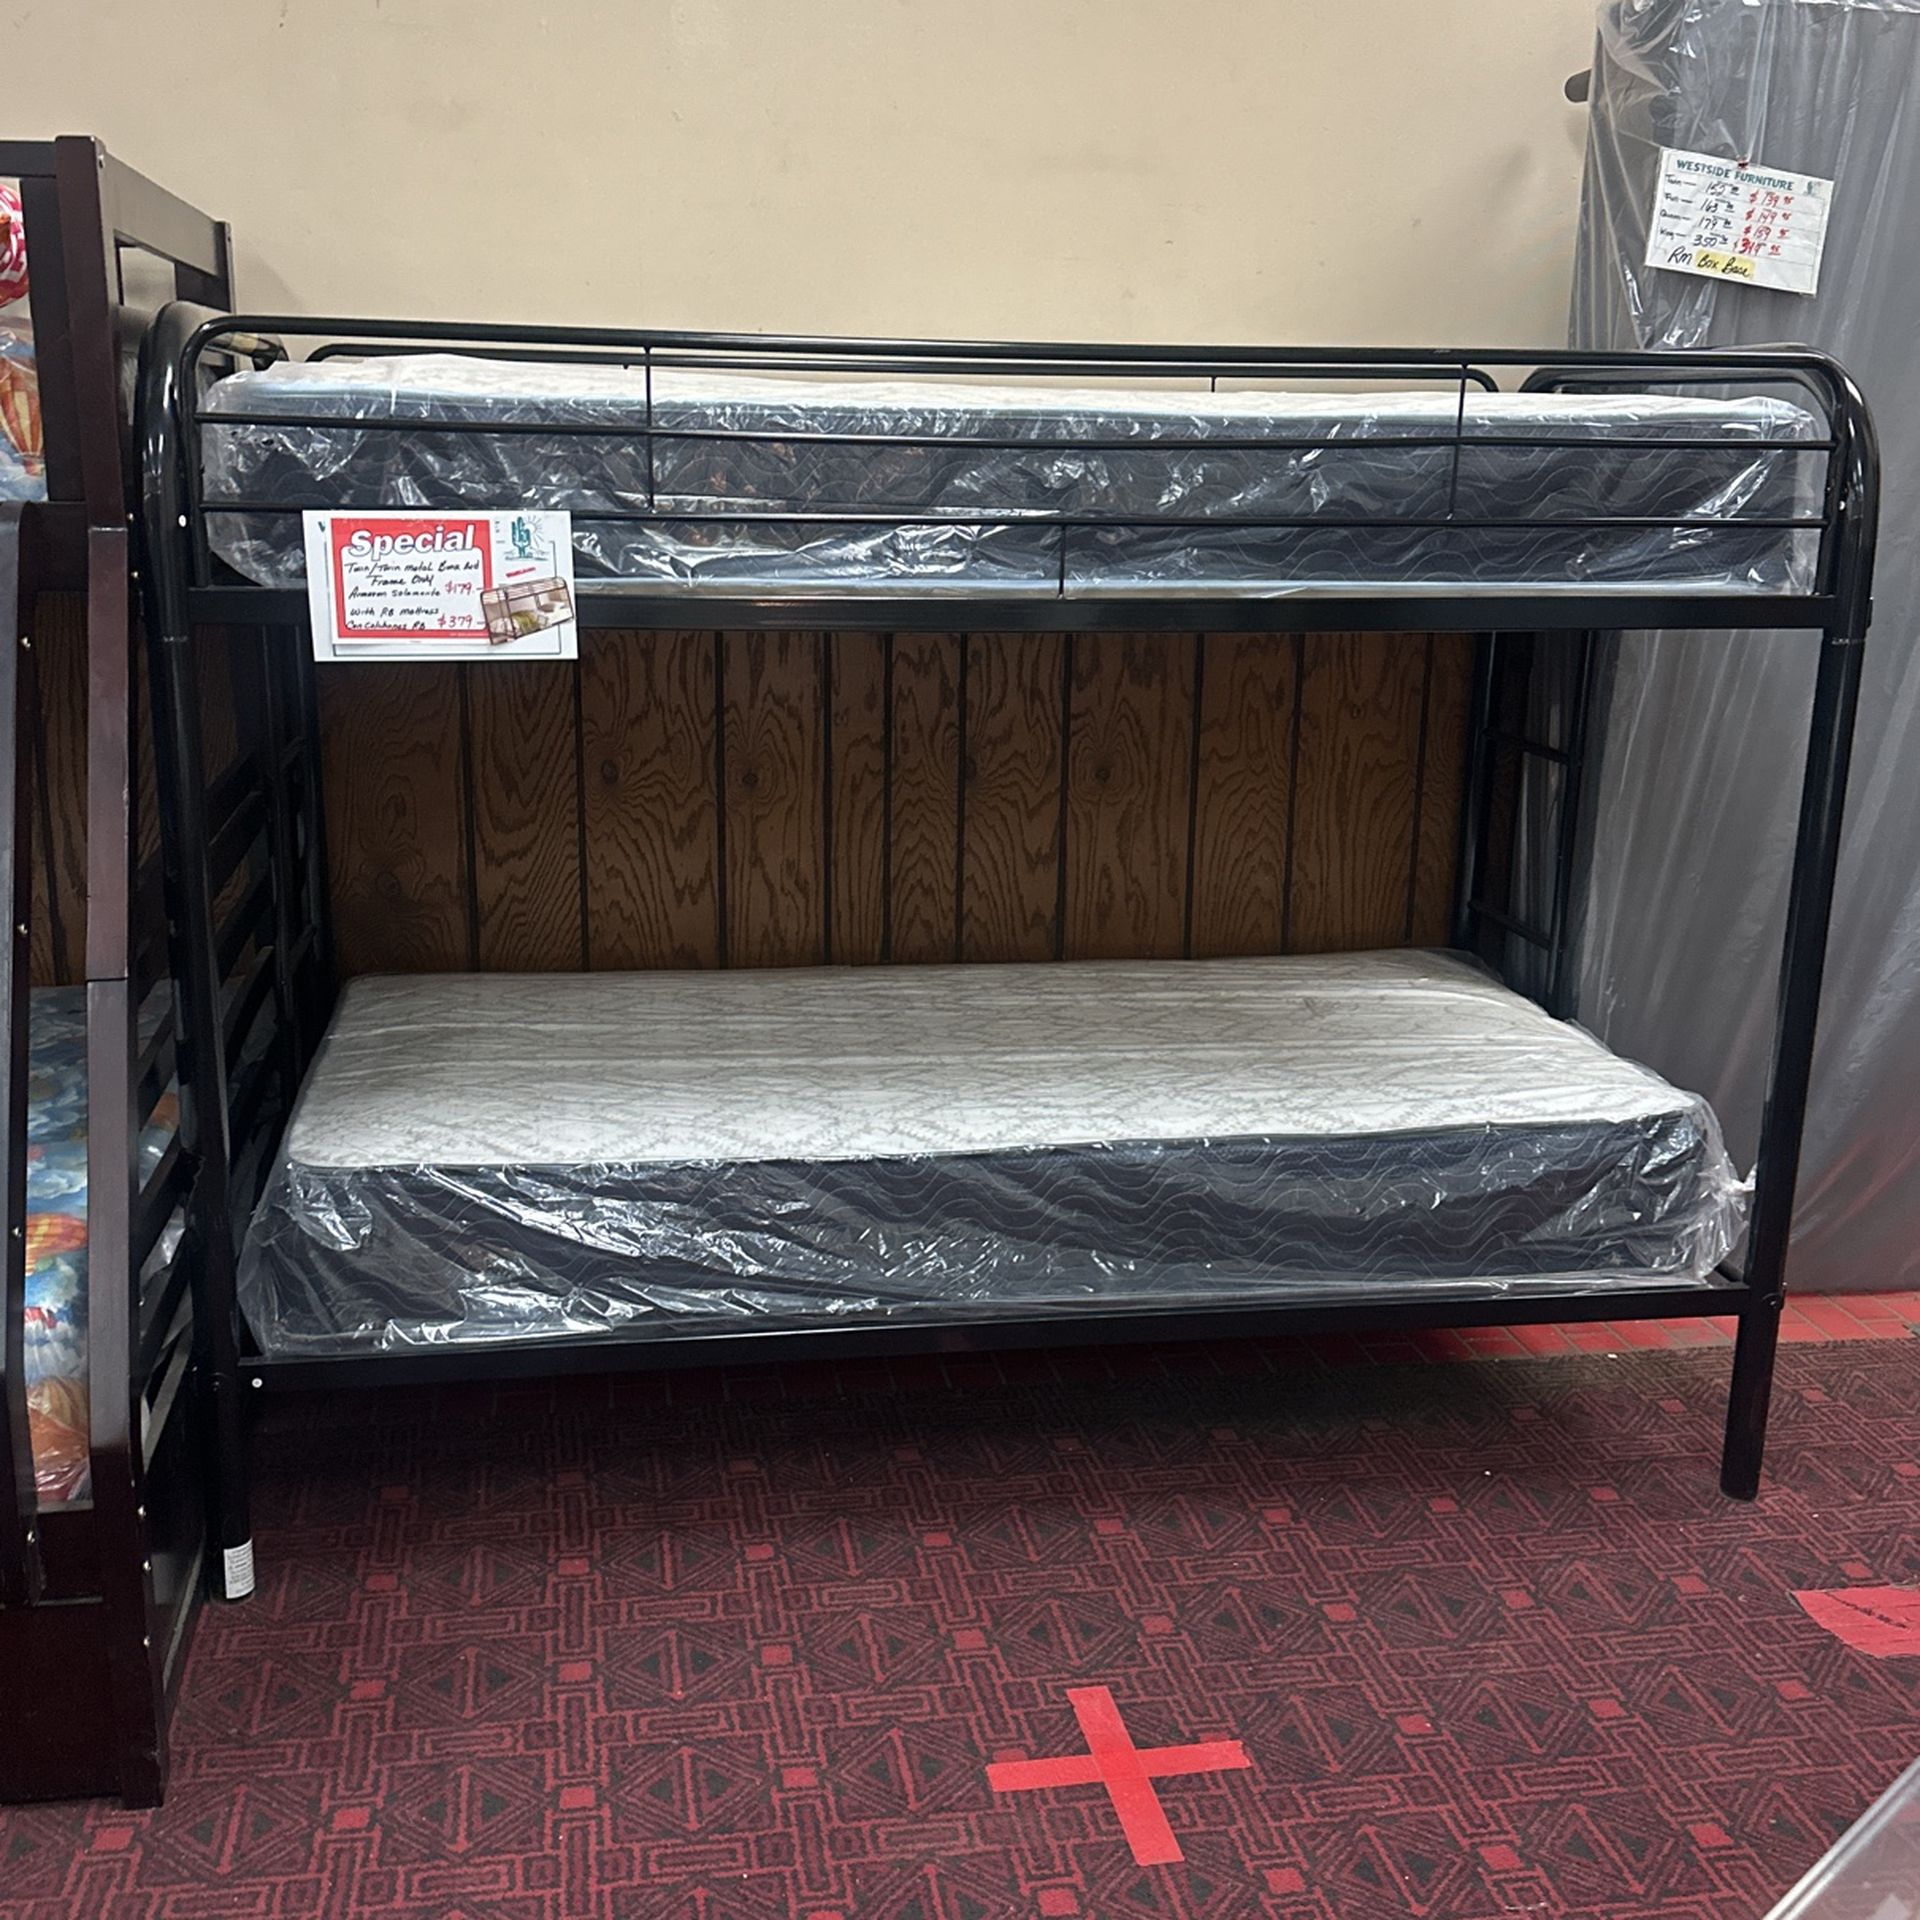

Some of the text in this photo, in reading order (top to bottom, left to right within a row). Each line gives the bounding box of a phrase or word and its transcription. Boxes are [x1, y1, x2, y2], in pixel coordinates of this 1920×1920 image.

[1676, 159, 1794, 191] WESTSIDE FURNITURE
[348, 520, 475, 561] Special
